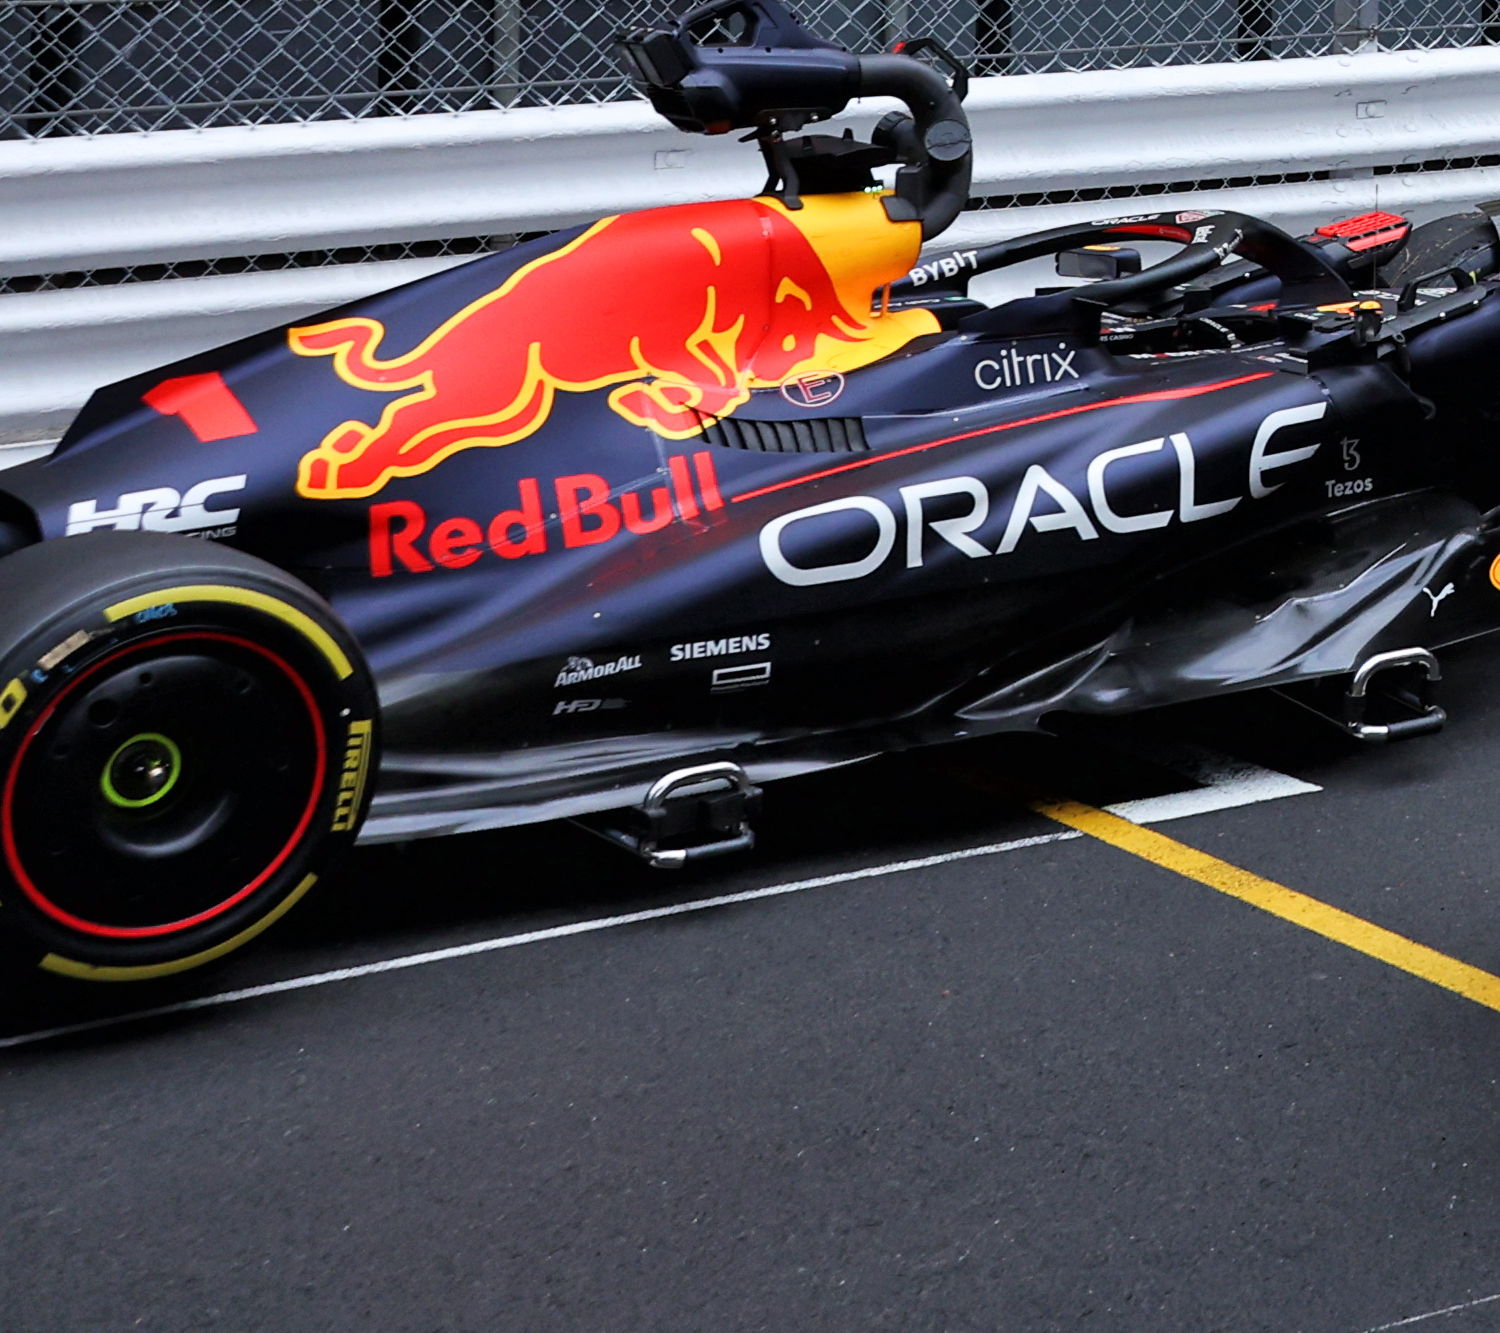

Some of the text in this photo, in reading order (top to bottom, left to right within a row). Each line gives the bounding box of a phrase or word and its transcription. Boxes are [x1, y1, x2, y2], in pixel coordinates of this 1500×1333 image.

[1091, 214, 1160, 226] ORACLE
[908, 250, 978, 287] BYBIT
[66, 474, 248, 537] HRC
[759, 401, 1327, 587] ORACLE
[1325, 474, 1374, 497] Tezos
[369, 450, 725, 578] Red Bull
[670, 633, 771, 662] SIEMENS
[331, 719, 373, 833] PIRELLI
